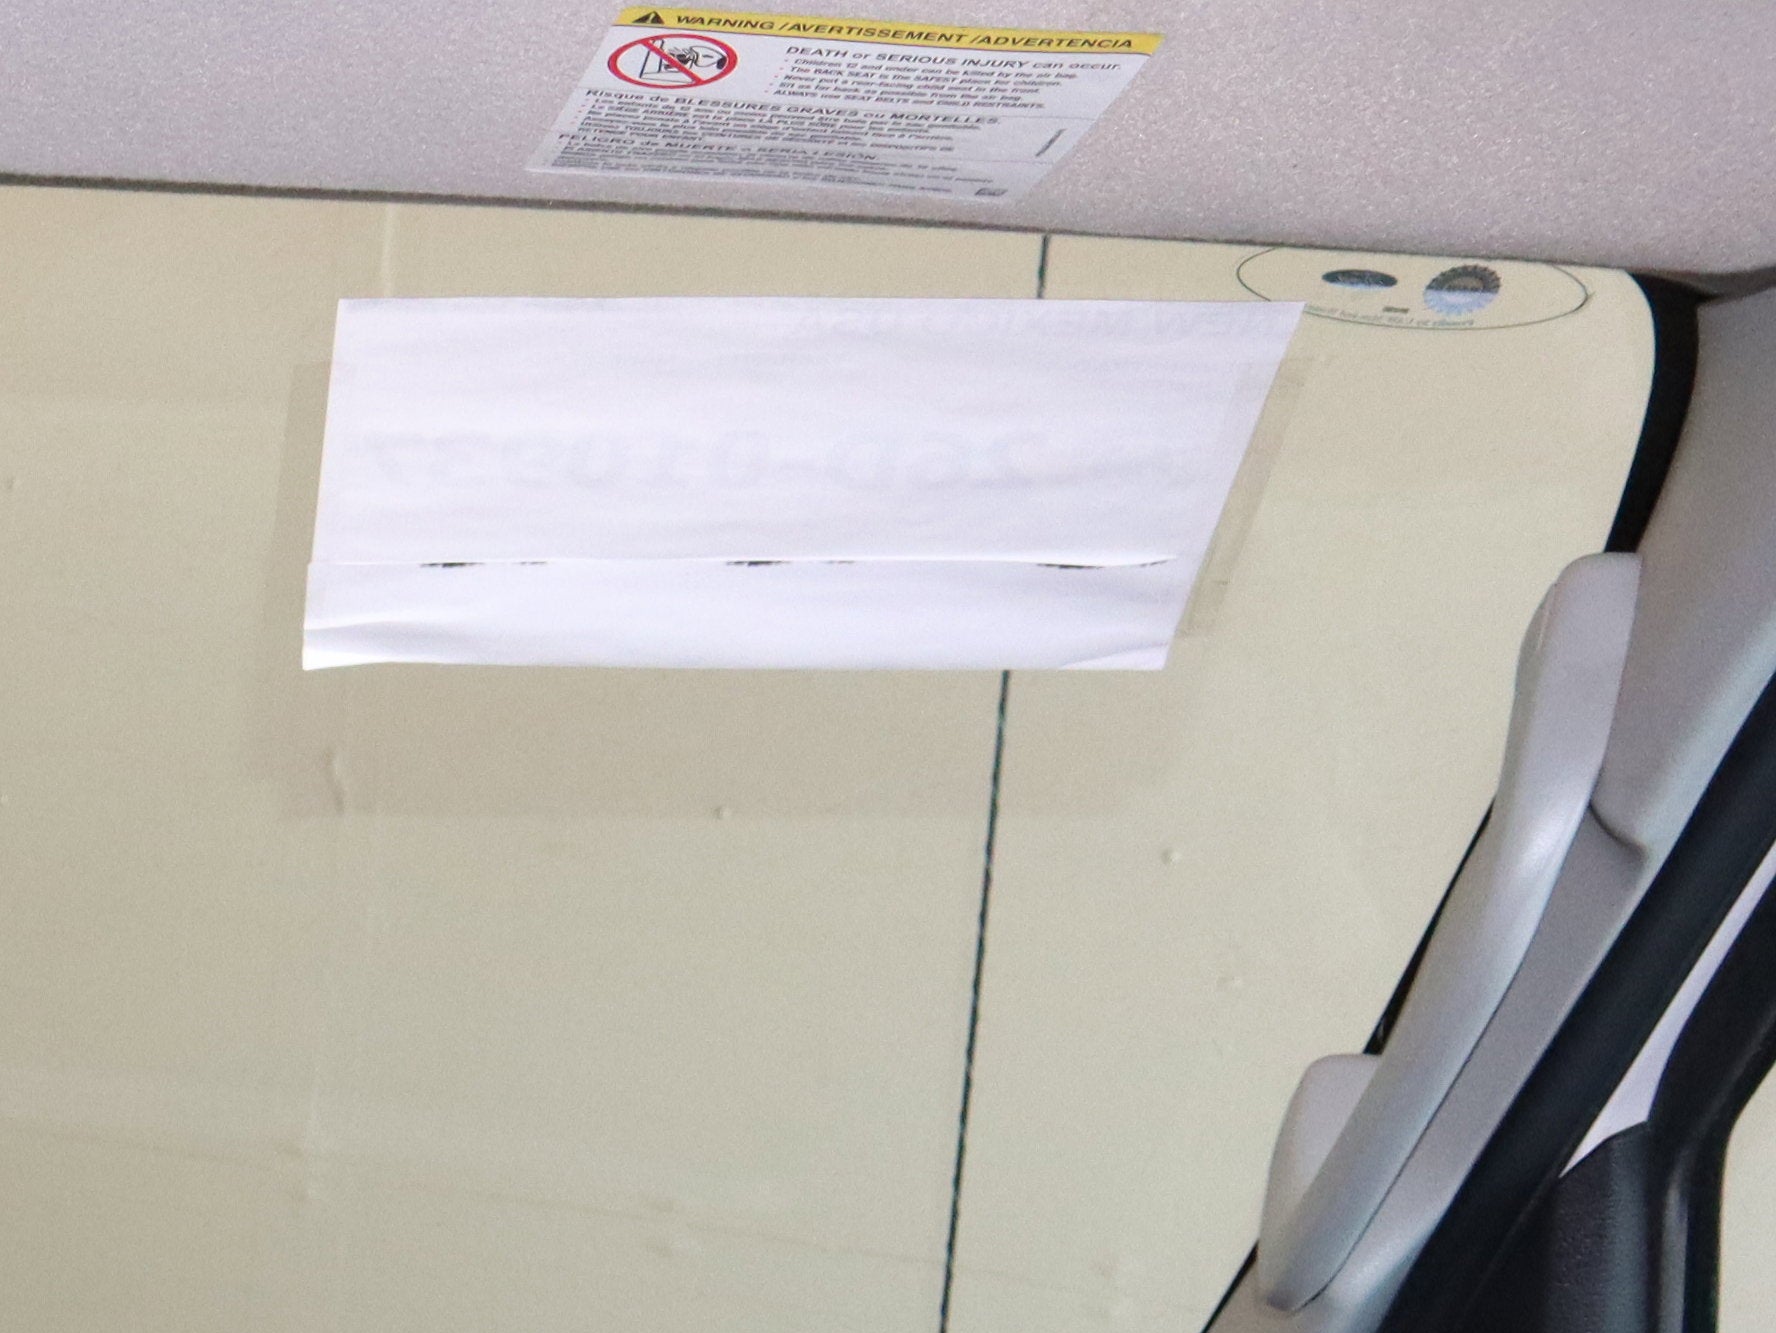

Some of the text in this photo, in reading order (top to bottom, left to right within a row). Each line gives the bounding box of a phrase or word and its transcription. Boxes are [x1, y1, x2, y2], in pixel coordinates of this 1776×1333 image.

[675, 15, 774, 30] WARNING
[786, 46, 848, 59] DEATH
[852, 51, 870, 59] or
[875, 53, 957, 65] SERIOUS
[961, 58, 1029, 69] INJURY
